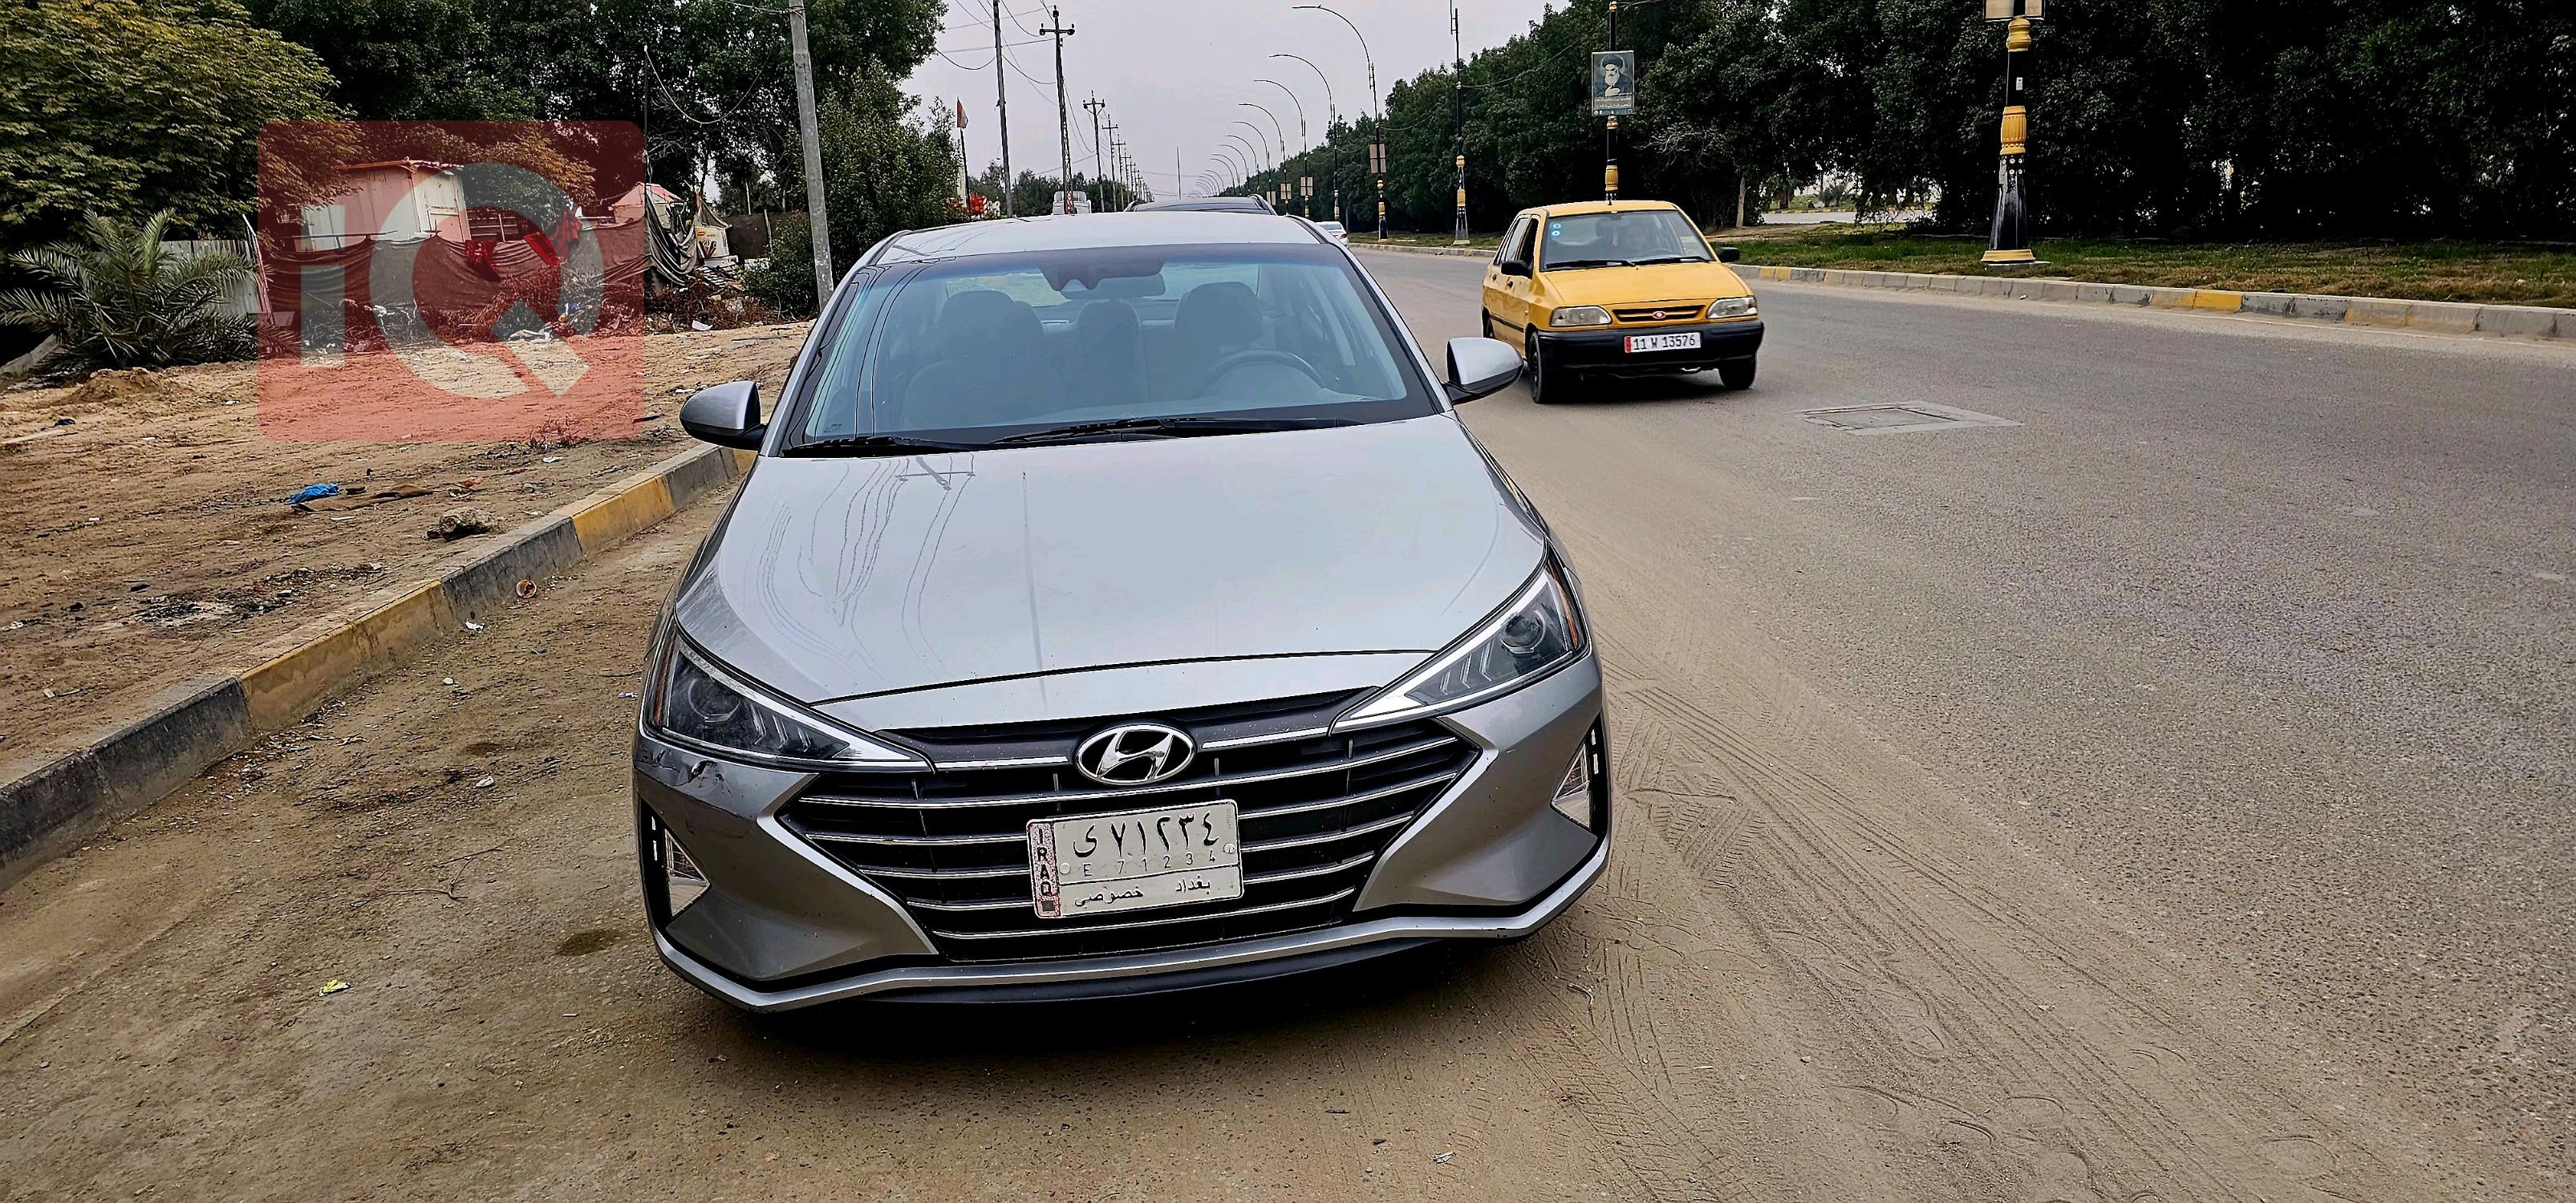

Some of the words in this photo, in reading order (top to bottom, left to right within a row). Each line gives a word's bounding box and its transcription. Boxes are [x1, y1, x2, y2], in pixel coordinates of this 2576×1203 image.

[1633, 338, 1647, 350] 11
[1661, 334, 1696, 348] 13576
[1036, 828, 1054, 897] IRAQ
[1175, 874, 1211, 895] بغداد
